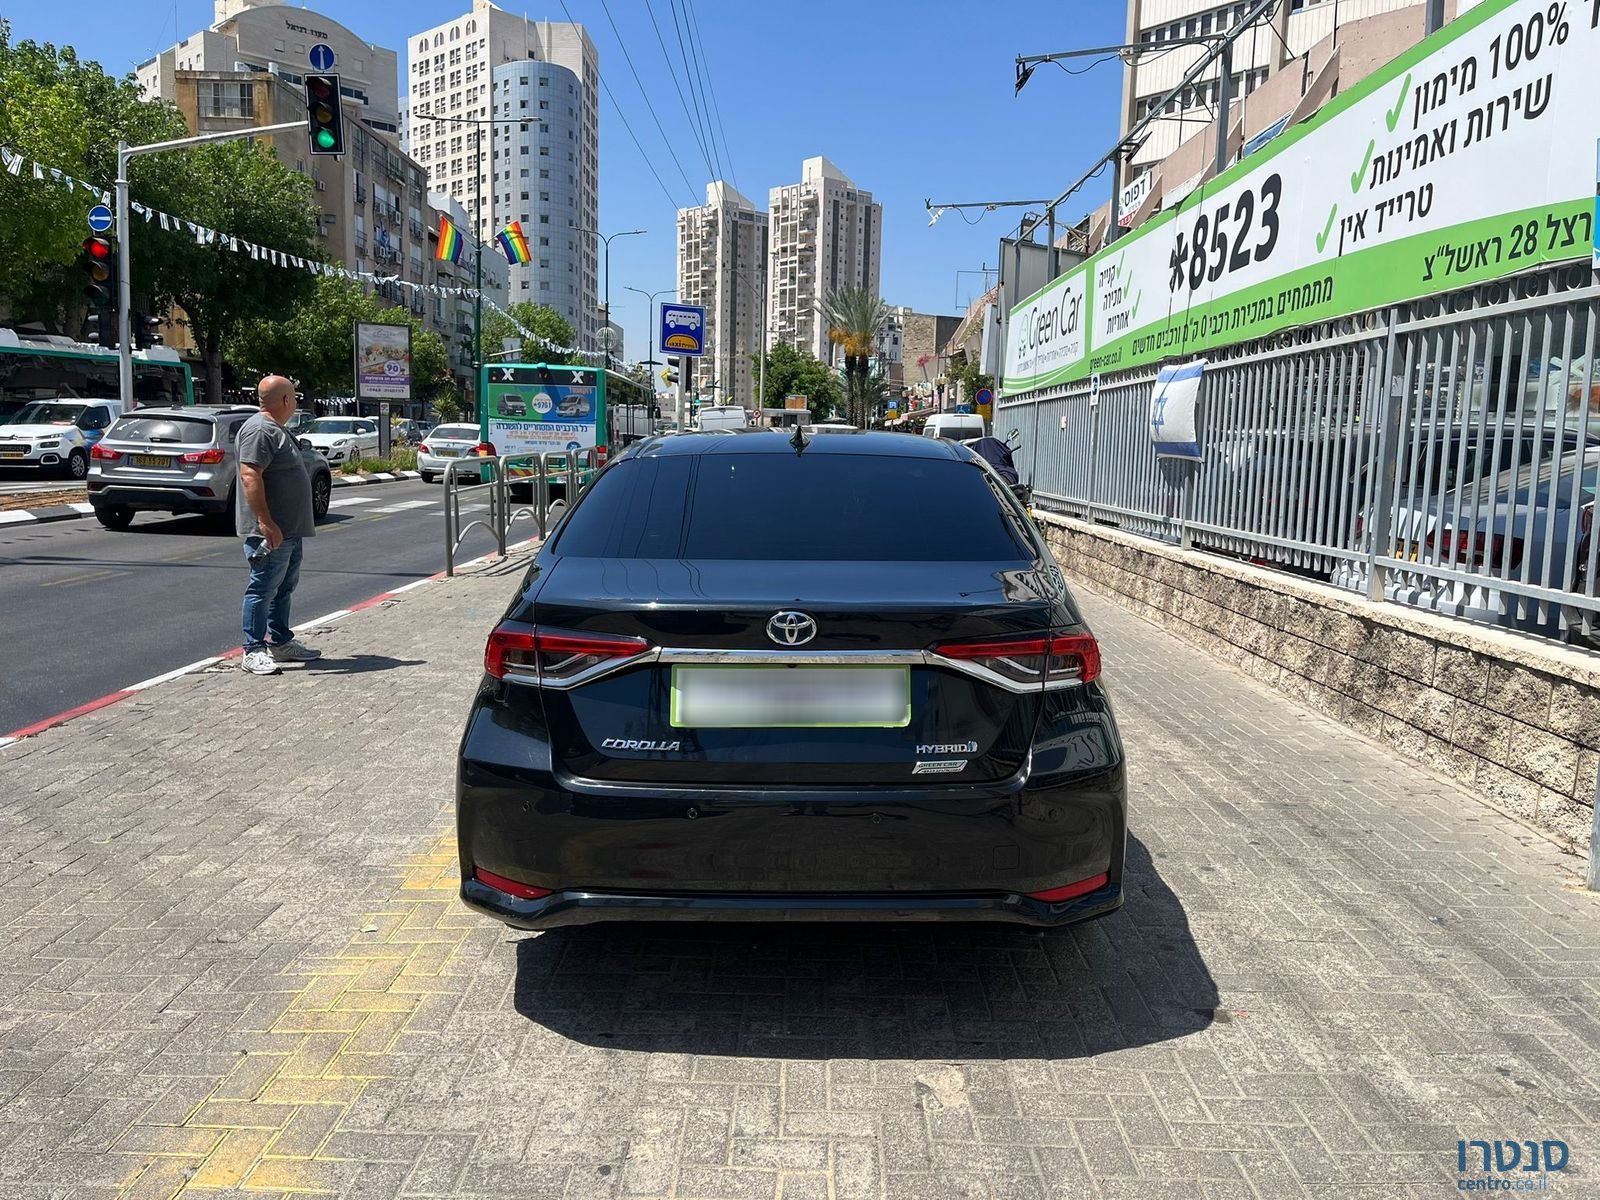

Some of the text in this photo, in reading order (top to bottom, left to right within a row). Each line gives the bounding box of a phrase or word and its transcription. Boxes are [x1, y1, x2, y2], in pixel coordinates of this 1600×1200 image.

[285, 19, 307, 34] דניאל
[1413, 1, 1569, 130] 100% מימון
[1369, 72, 1553, 190] שירות ואמינות
[1124, 178, 1146, 207] דפוס
[1338, 182, 1434, 257] טרייד אין
[1546, 211, 1594, 250] רצל
[1507, 219, 1540, 261] 28
[1099, 265, 1116, 289] קנייה
[1103, 287, 1122, 311] מכירה
[1277, 275, 1333, 314] מתמחים
[1029, 286, 1082, 350] Green Car
[1106, 309, 1130, 335] אחריות
[1209, 311, 1230, 335] רכבי
[1231, 295, 1273, 330] במכירת
[1156, 326, 1181, 350] ורכבים
[1201, 314, 1207, 338] 0
[1132, 334, 1155, 356] חדשים
[386, 364, 398, 373] 90
[1089, 346, 1123, 373] green-car.co.il
[496, 422, 522, 431] להשכרה
[556, 424, 578, 432] הרכבים
[578, 424, 588, 433] כל
[601, 738, 680, 751] COROLLA
[916, 744, 967, 754] HYBRID
